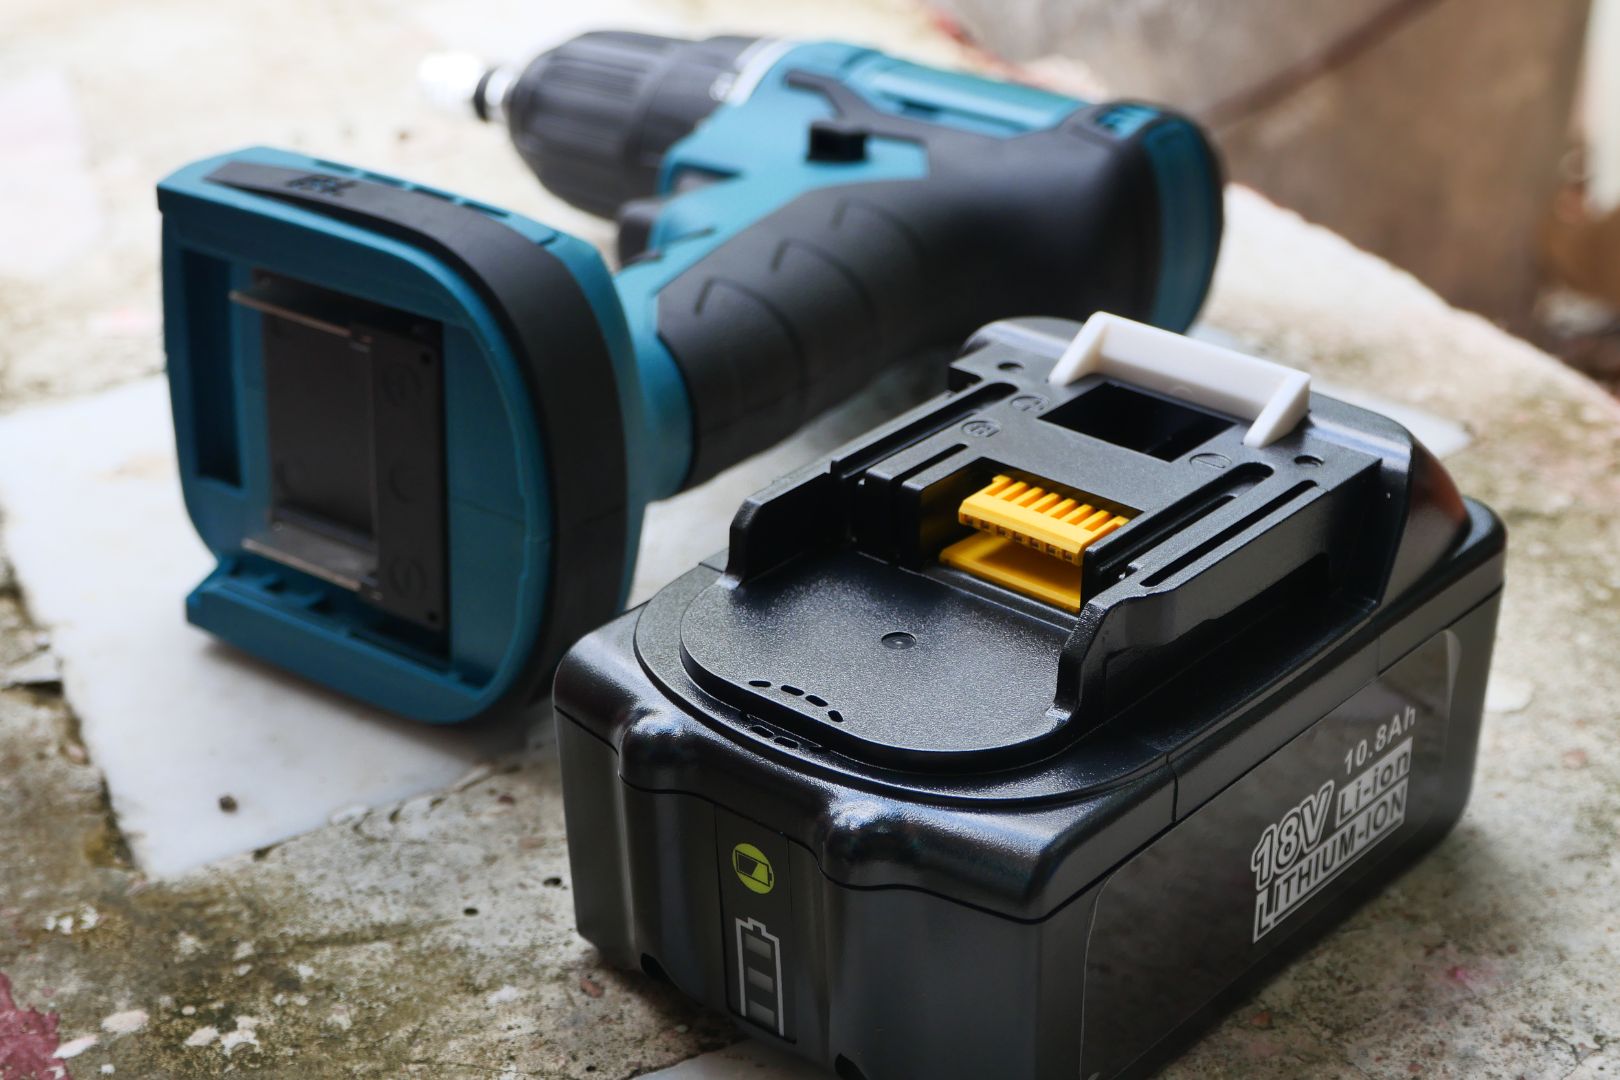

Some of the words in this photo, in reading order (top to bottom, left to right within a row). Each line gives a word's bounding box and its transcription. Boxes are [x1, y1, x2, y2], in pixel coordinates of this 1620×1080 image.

[1344, 705, 1416, 776] 10.8Ah
[1250, 779, 1335, 891] 18V
[1339, 750, 1411, 819] Li-ion
[1255, 783, 1407, 937] LITHIUM-ION
